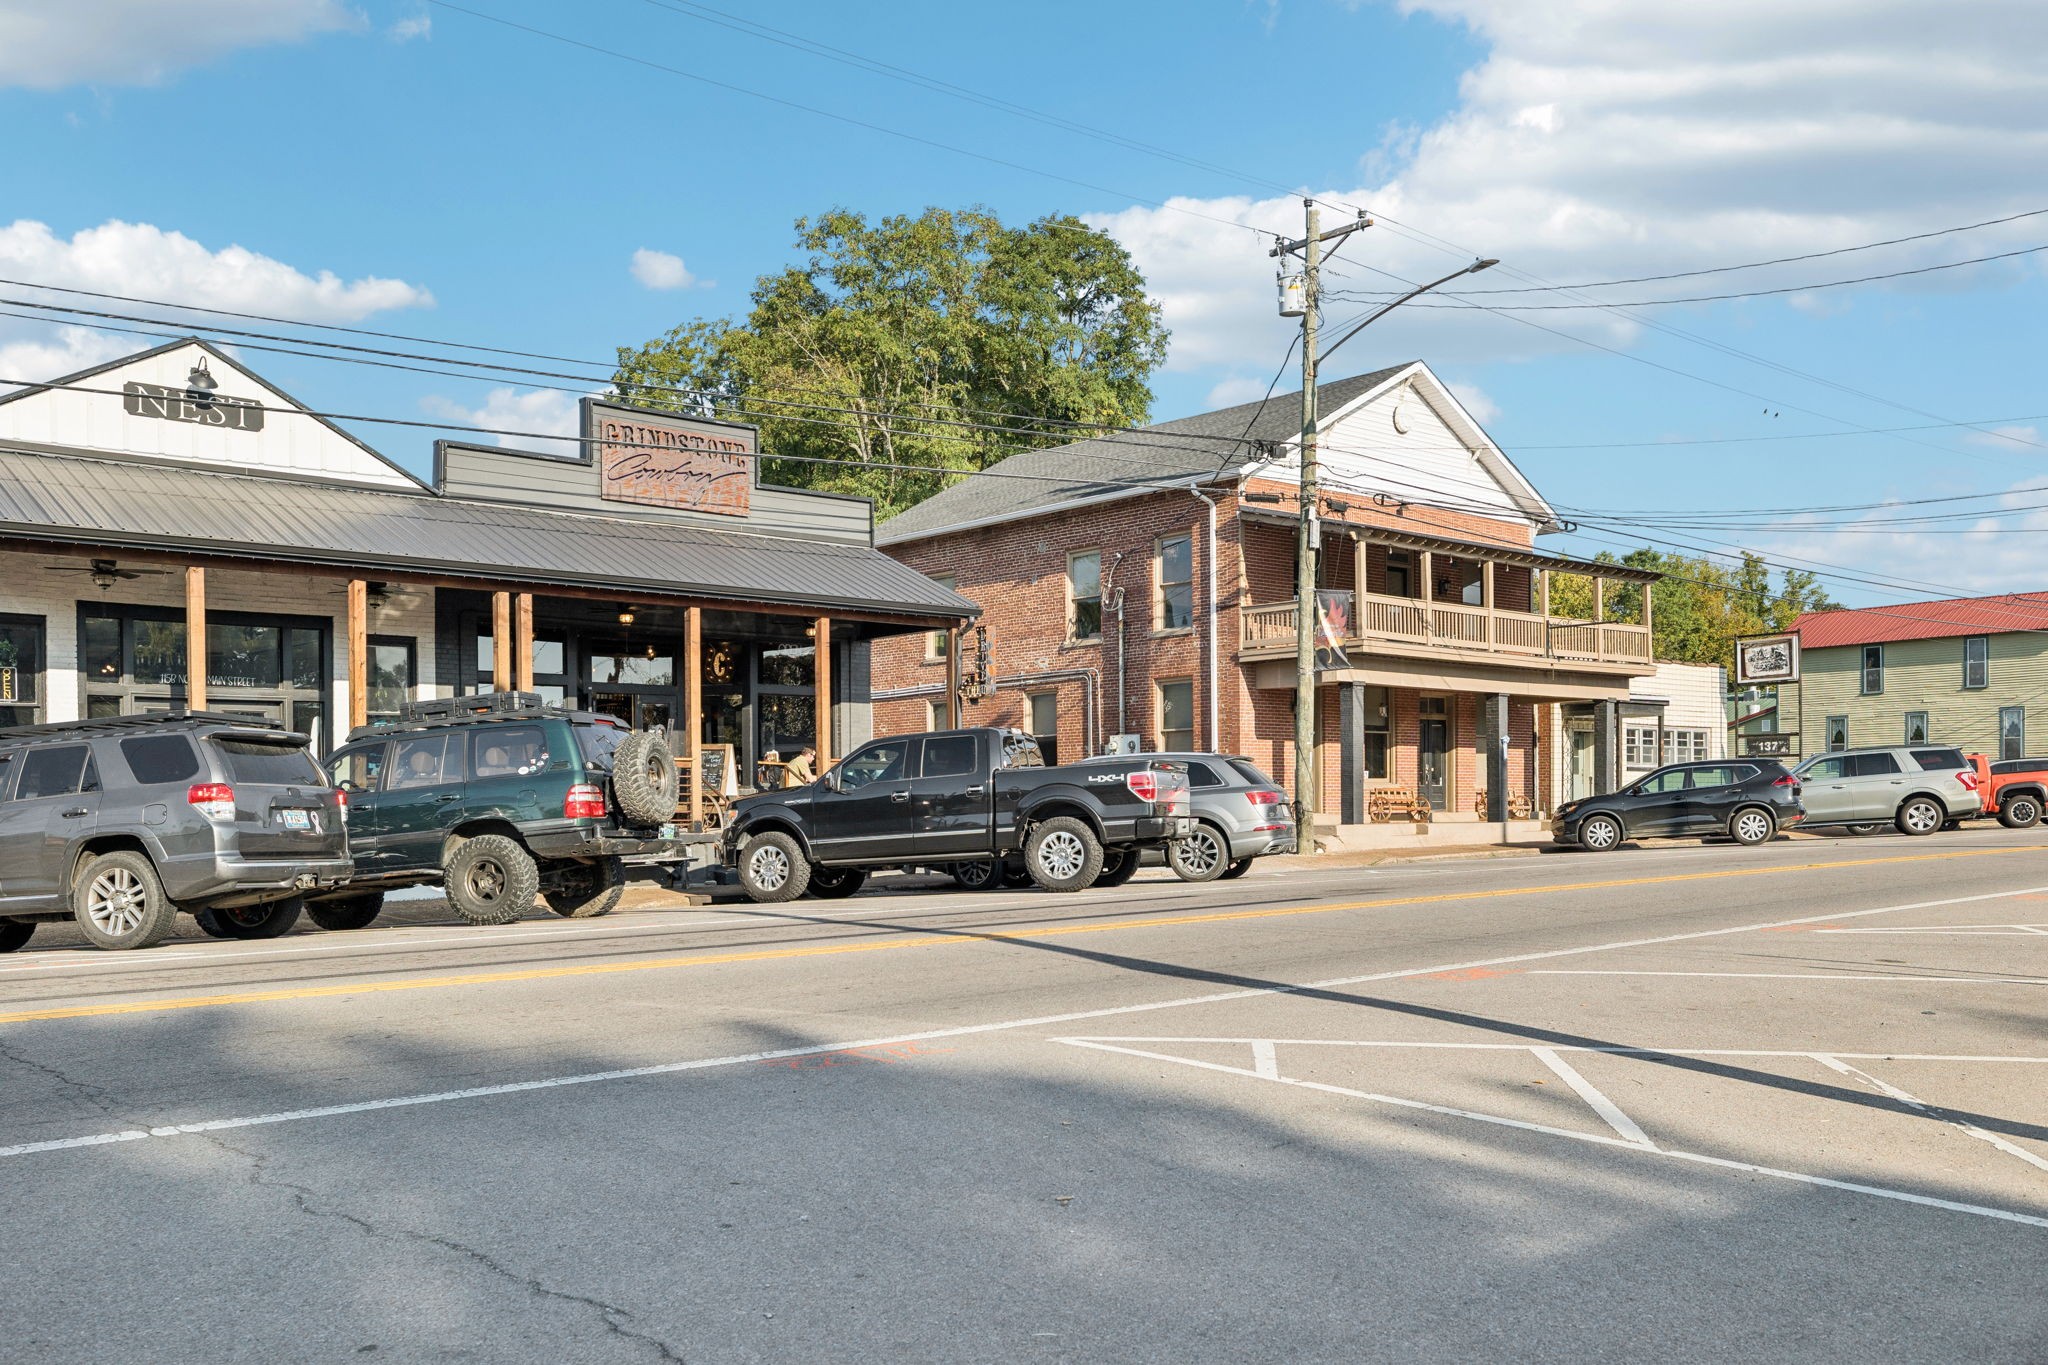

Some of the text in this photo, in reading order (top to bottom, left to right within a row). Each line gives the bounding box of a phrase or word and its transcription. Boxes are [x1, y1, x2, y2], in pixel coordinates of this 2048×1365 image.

[134, 385, 255, 428] NEST
[606, 423, 746, 467] GRINDSTONE
[713, 652, 725, 677] C
[2, 668, 12, 701] OPEN
[207, 675, 227, 686] MAIN
[227, 676, 257, 687] STREET
[1759, 741, 1778, 751] 137
